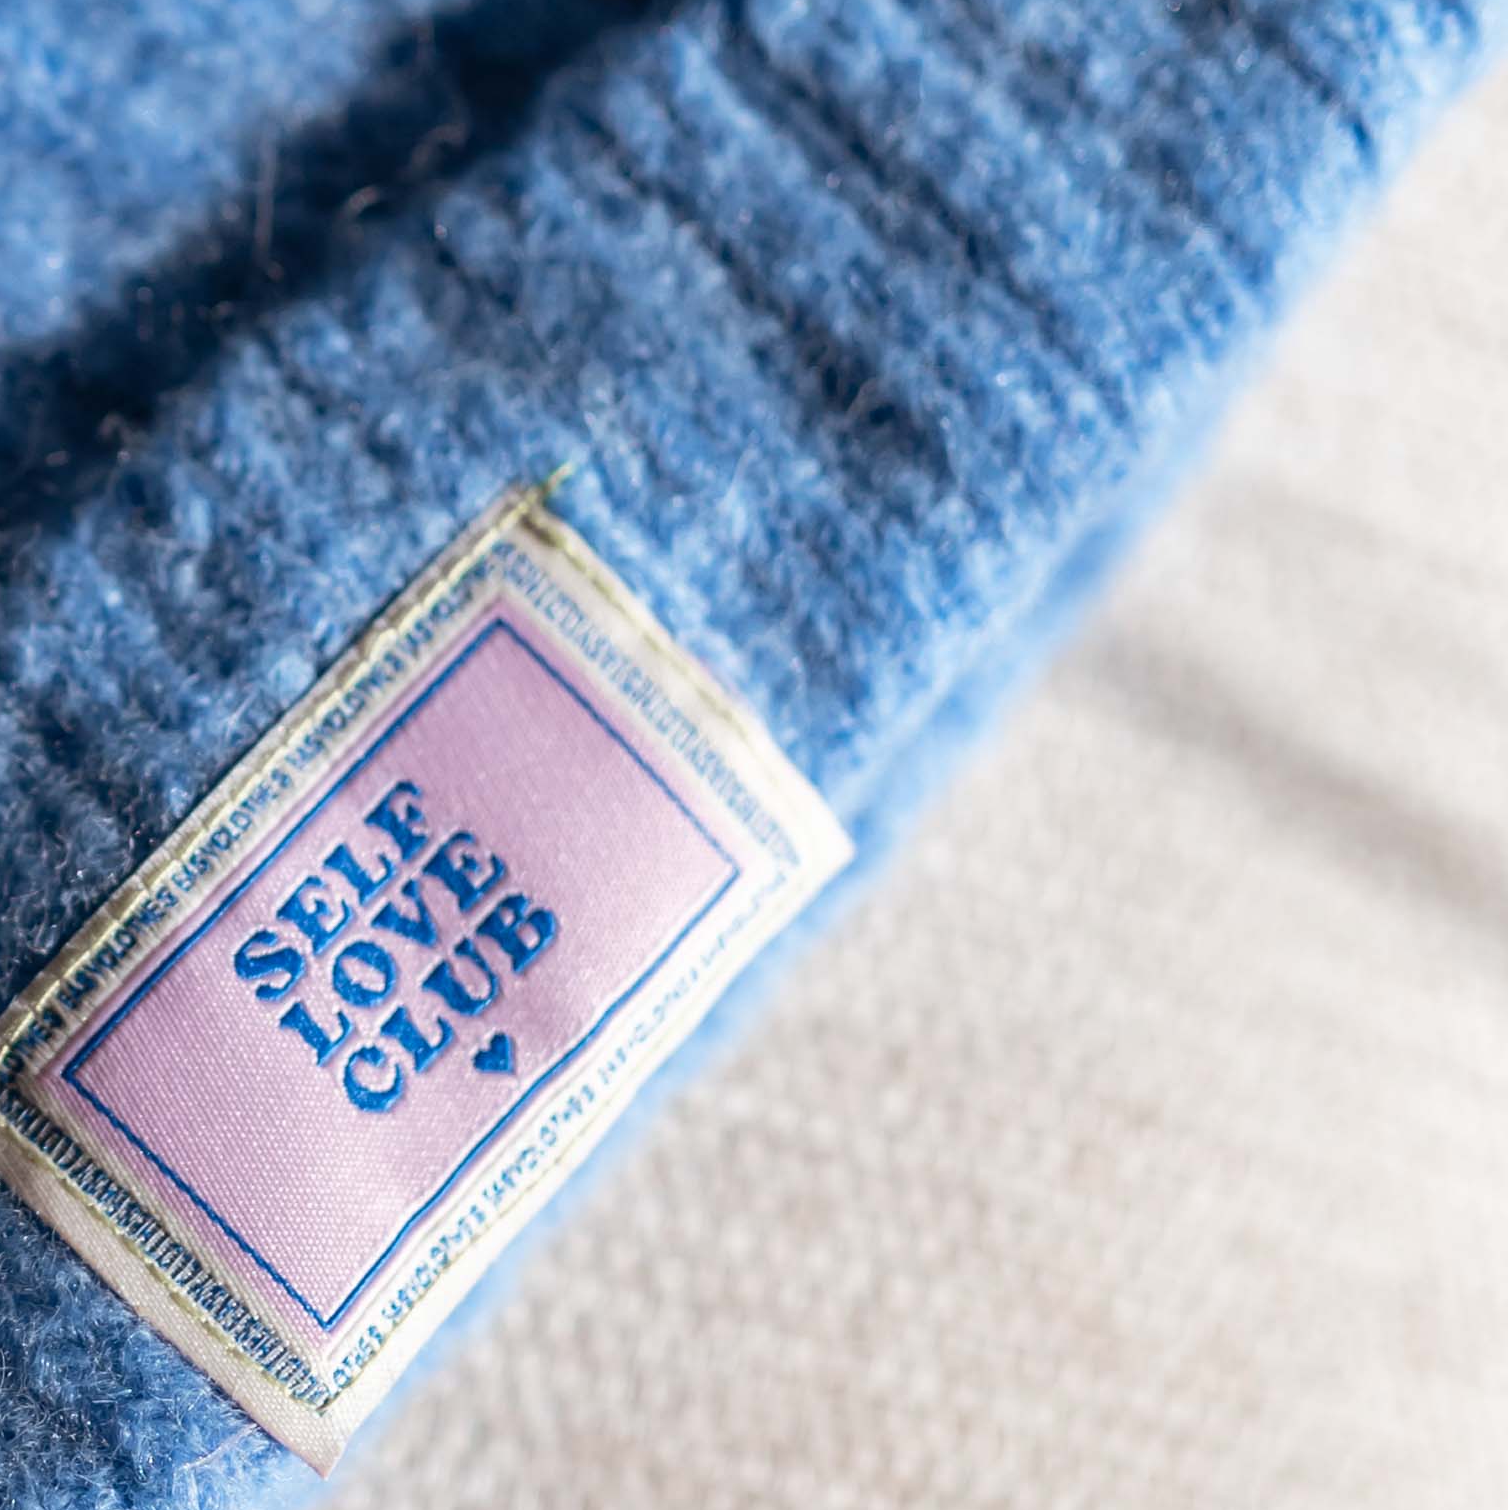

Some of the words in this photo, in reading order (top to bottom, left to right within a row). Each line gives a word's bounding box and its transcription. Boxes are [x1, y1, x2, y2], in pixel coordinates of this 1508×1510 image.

[234, 780, 429, 1002] SELF
[279, 831, 505, 1066] LOVE
[343, 893, 558, 1114] CLUB
